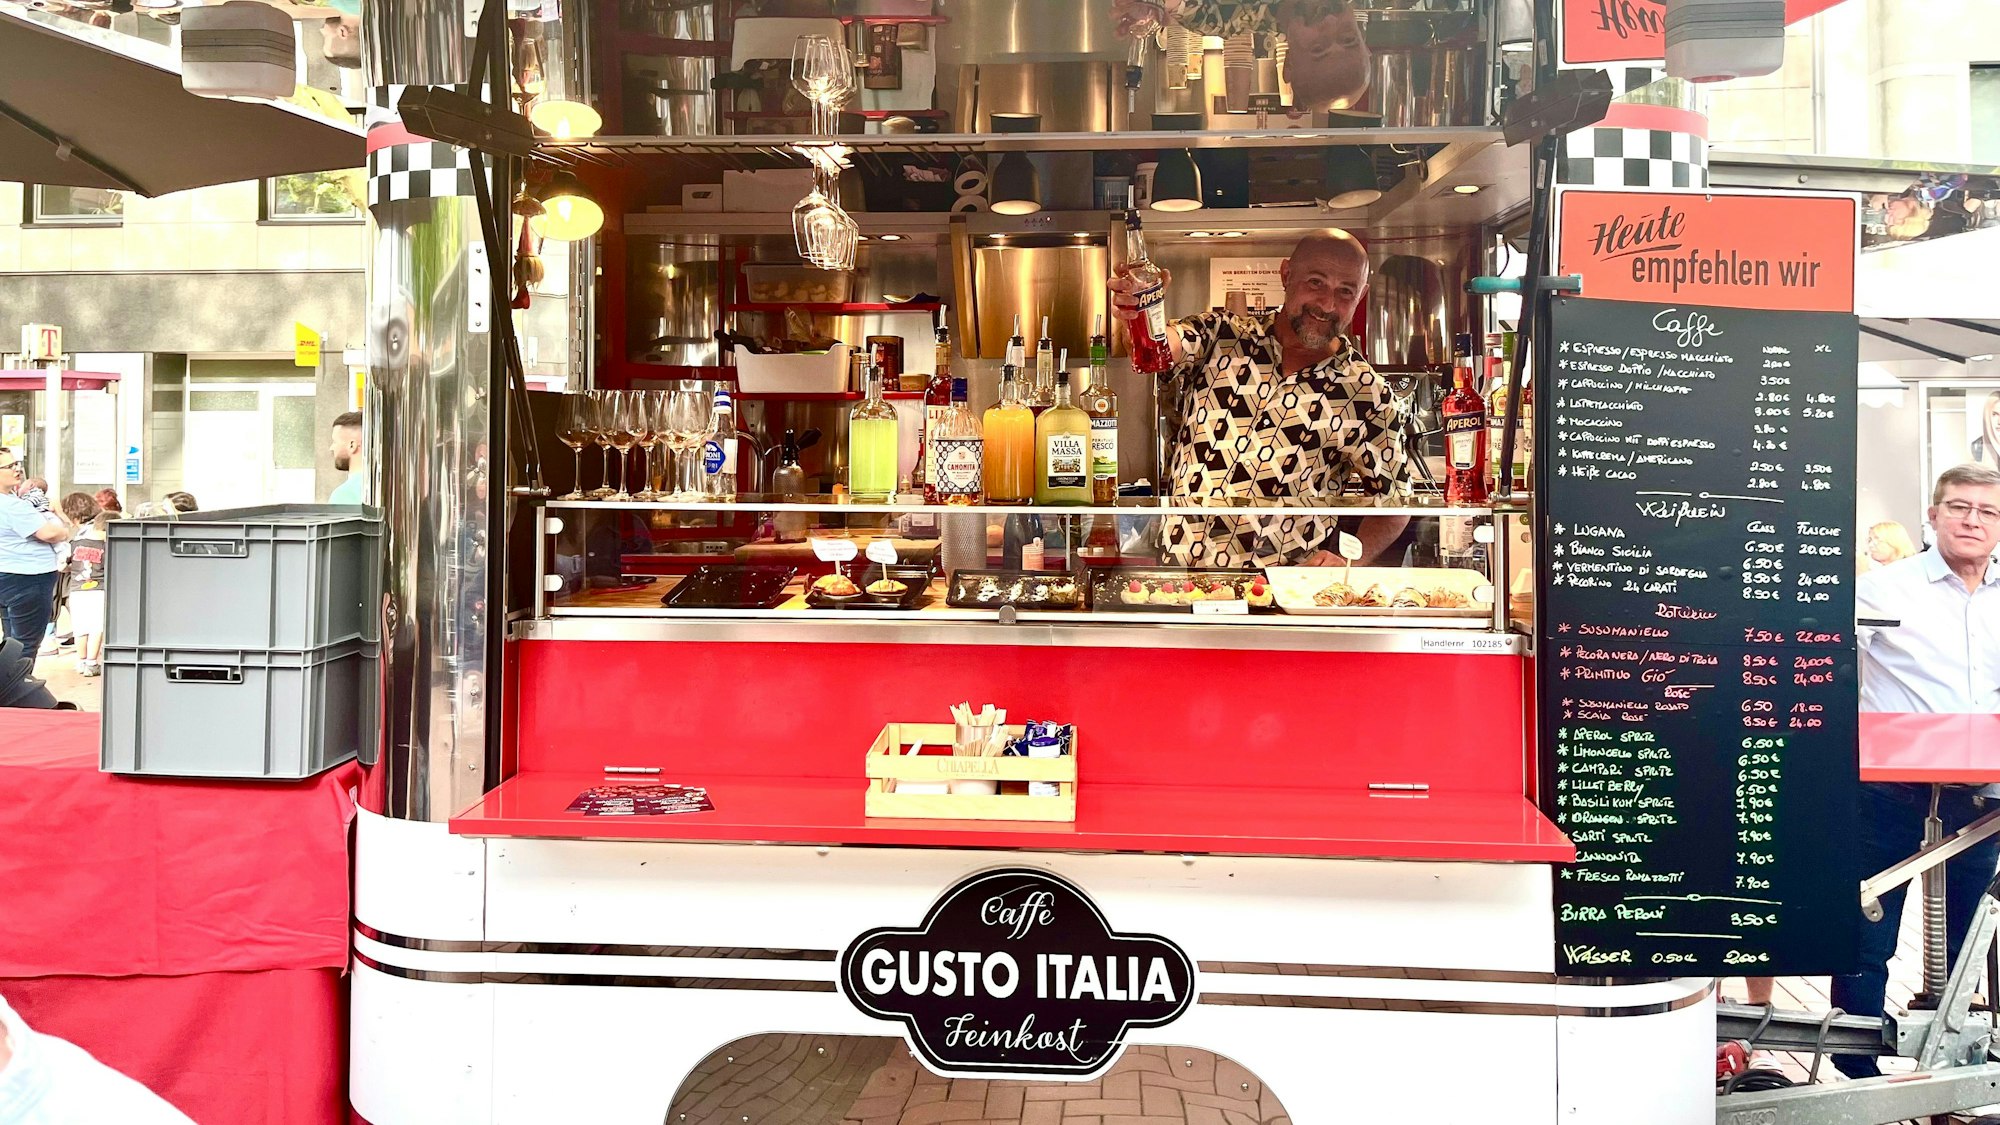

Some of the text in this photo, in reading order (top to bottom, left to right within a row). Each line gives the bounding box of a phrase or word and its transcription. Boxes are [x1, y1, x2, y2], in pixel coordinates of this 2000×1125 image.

[1588, 205, 1686, 256] Heute
[1632, 249, 1821, 293] empfehlen wir
[42, 328, 58, 357] T
[1446, 417, 1482, 432] APEROL
[1054, 440, 1079, 448] VILLA
[1606, 470, 1636, 479] CACAO
[1574, 524, 1625, 538] LUGANA
[1569, 541, 1604, 556] BIANCO
[1612, 545, 1652, 558] SICILIA
[1567, 562, 1632, 574] VERMENTINO
[1623, 580, 1639, 593] 24
[1472, 640, 1502, 648] 102185
[1574, 728, 1612, 740] APEROL
[1572, 763, 1622, 775] CAMPARI
[1572, 829, 1605, 843] SARTI
[1577, 869, 1620, 882] FRESCO
[1561, 904, 1606, 921] BIRRA
[1614, 904, 1665, 920] PERONI
[861, 948, 1177, 1003] GUSTO ITALIA
[944, 1013, 1094, 1064] Feinkost
